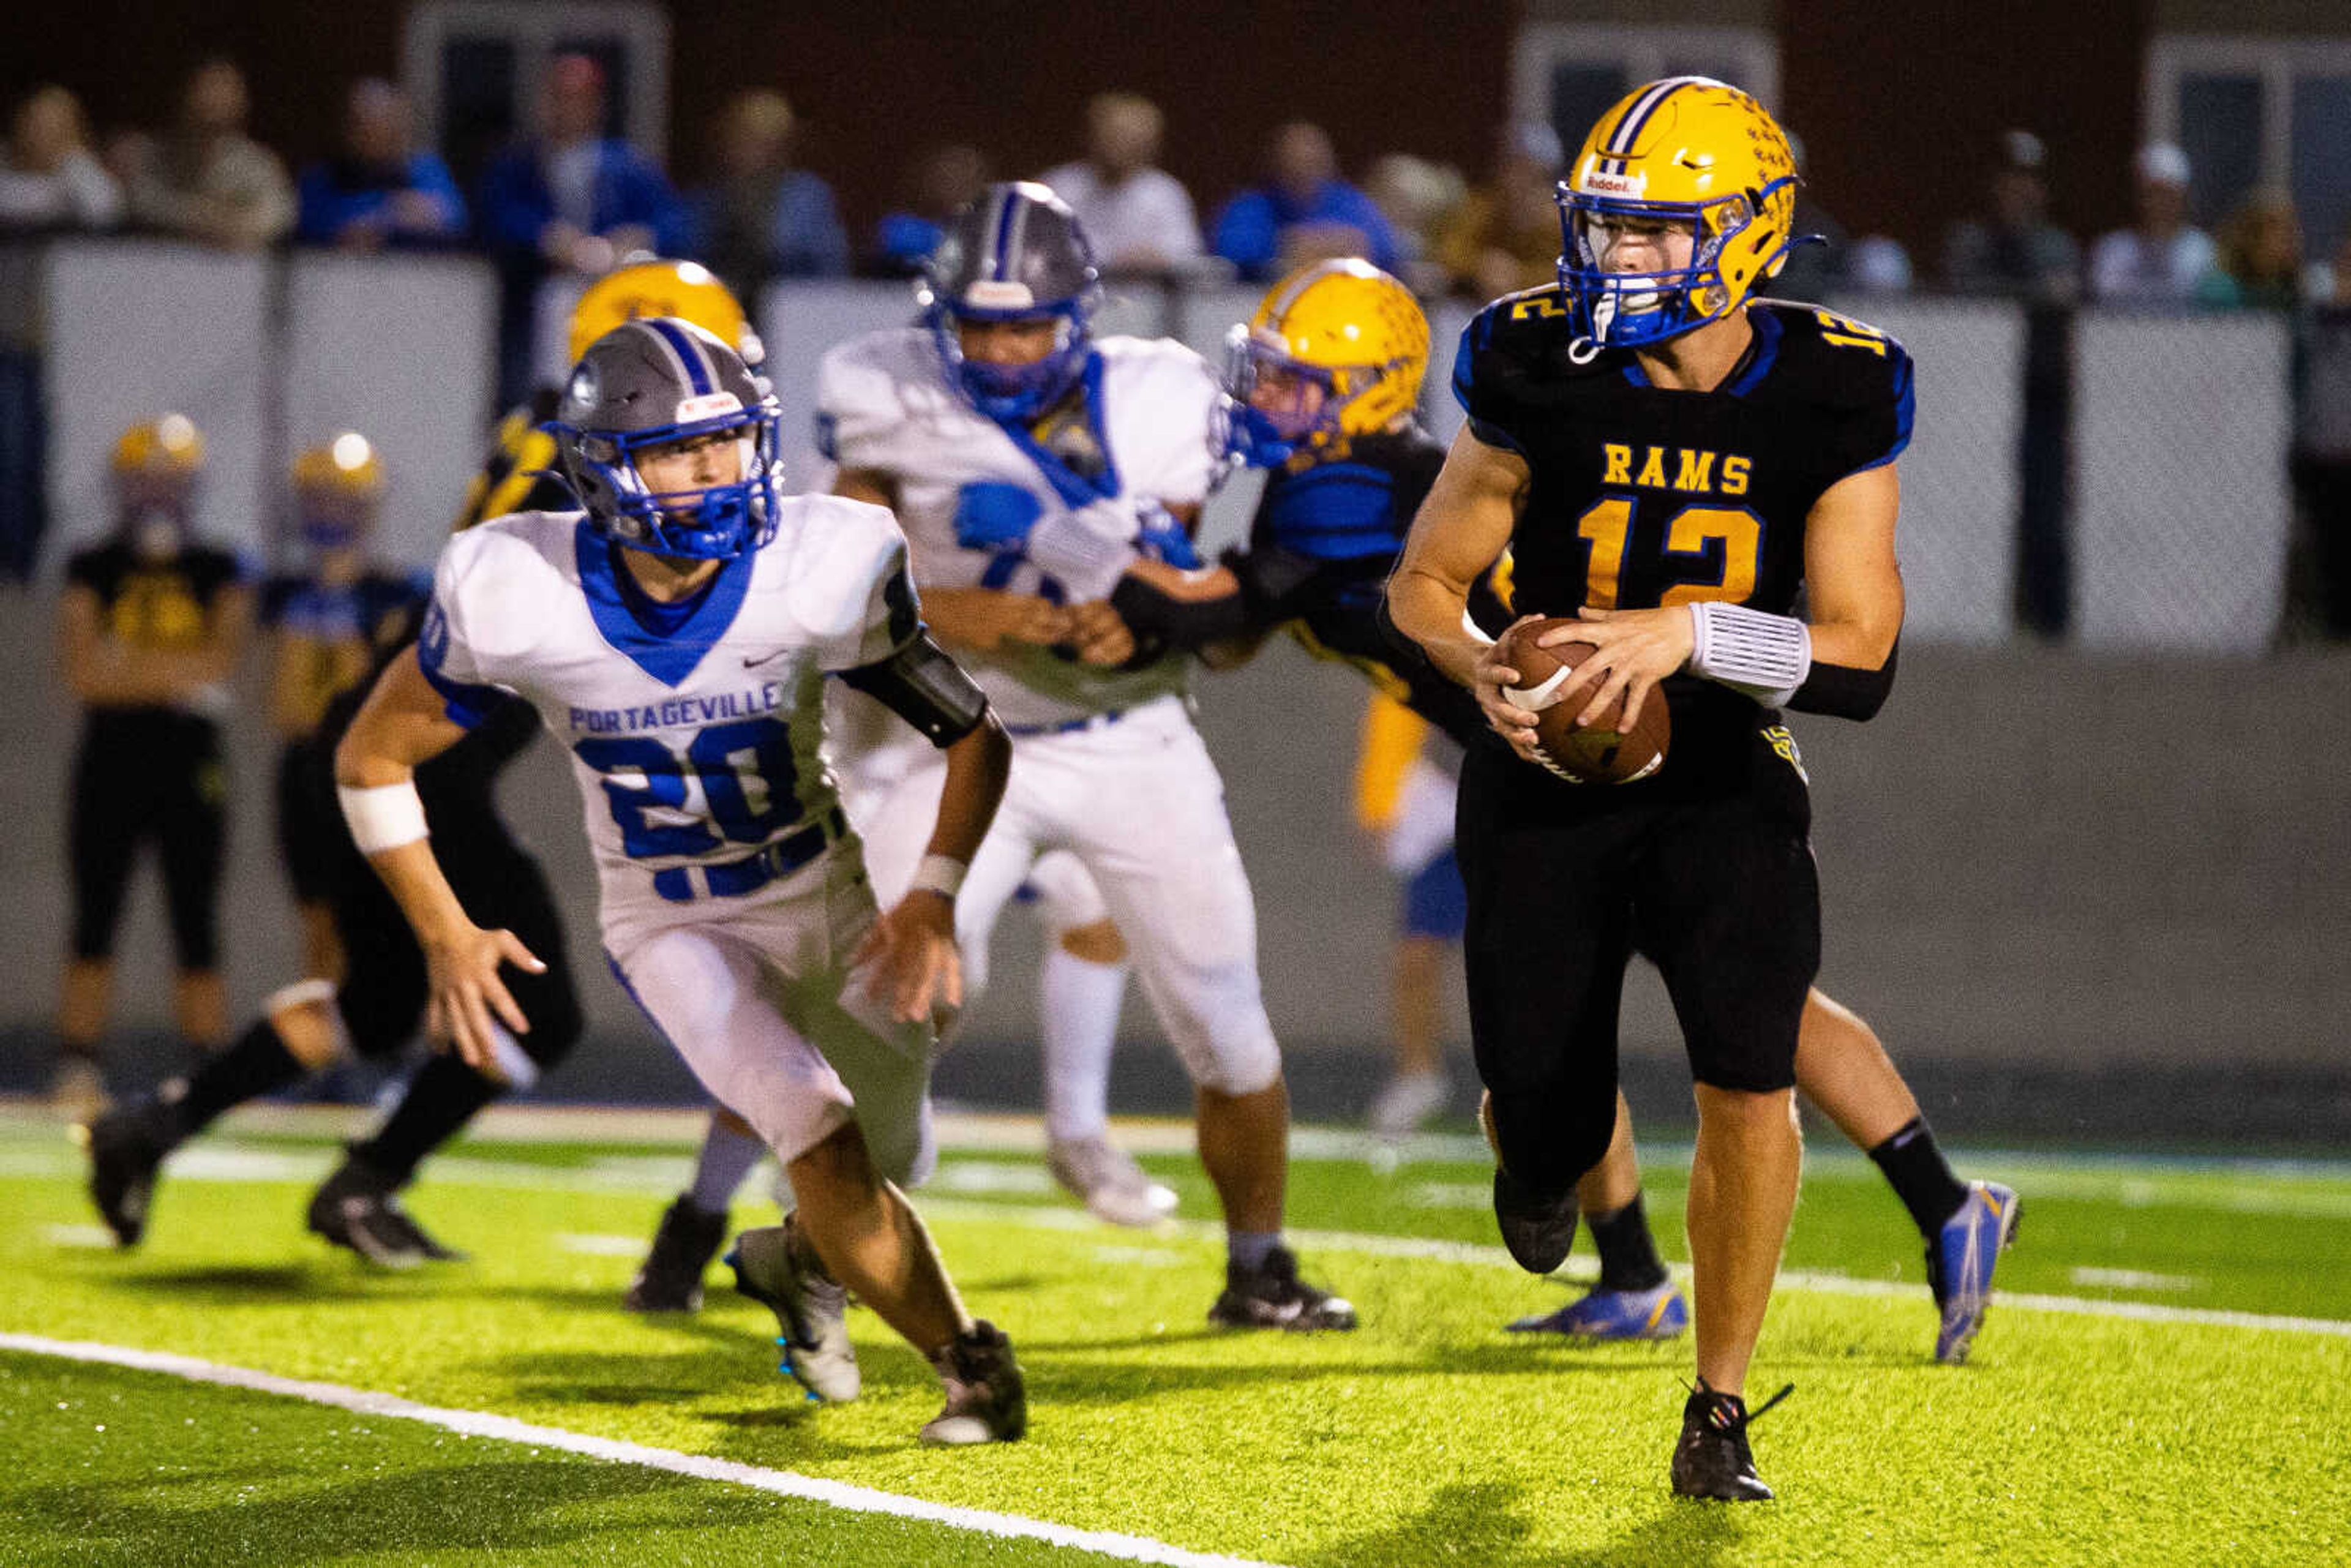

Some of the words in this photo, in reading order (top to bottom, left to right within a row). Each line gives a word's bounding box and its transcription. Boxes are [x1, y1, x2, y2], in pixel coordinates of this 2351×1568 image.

[1602, 443, 1753, 495] RAMS
[1577, 495, 1766, 610] 12
[569, 681, 781, 733] PORTAGEVILLE
[573, 716, 804, 858] 20
